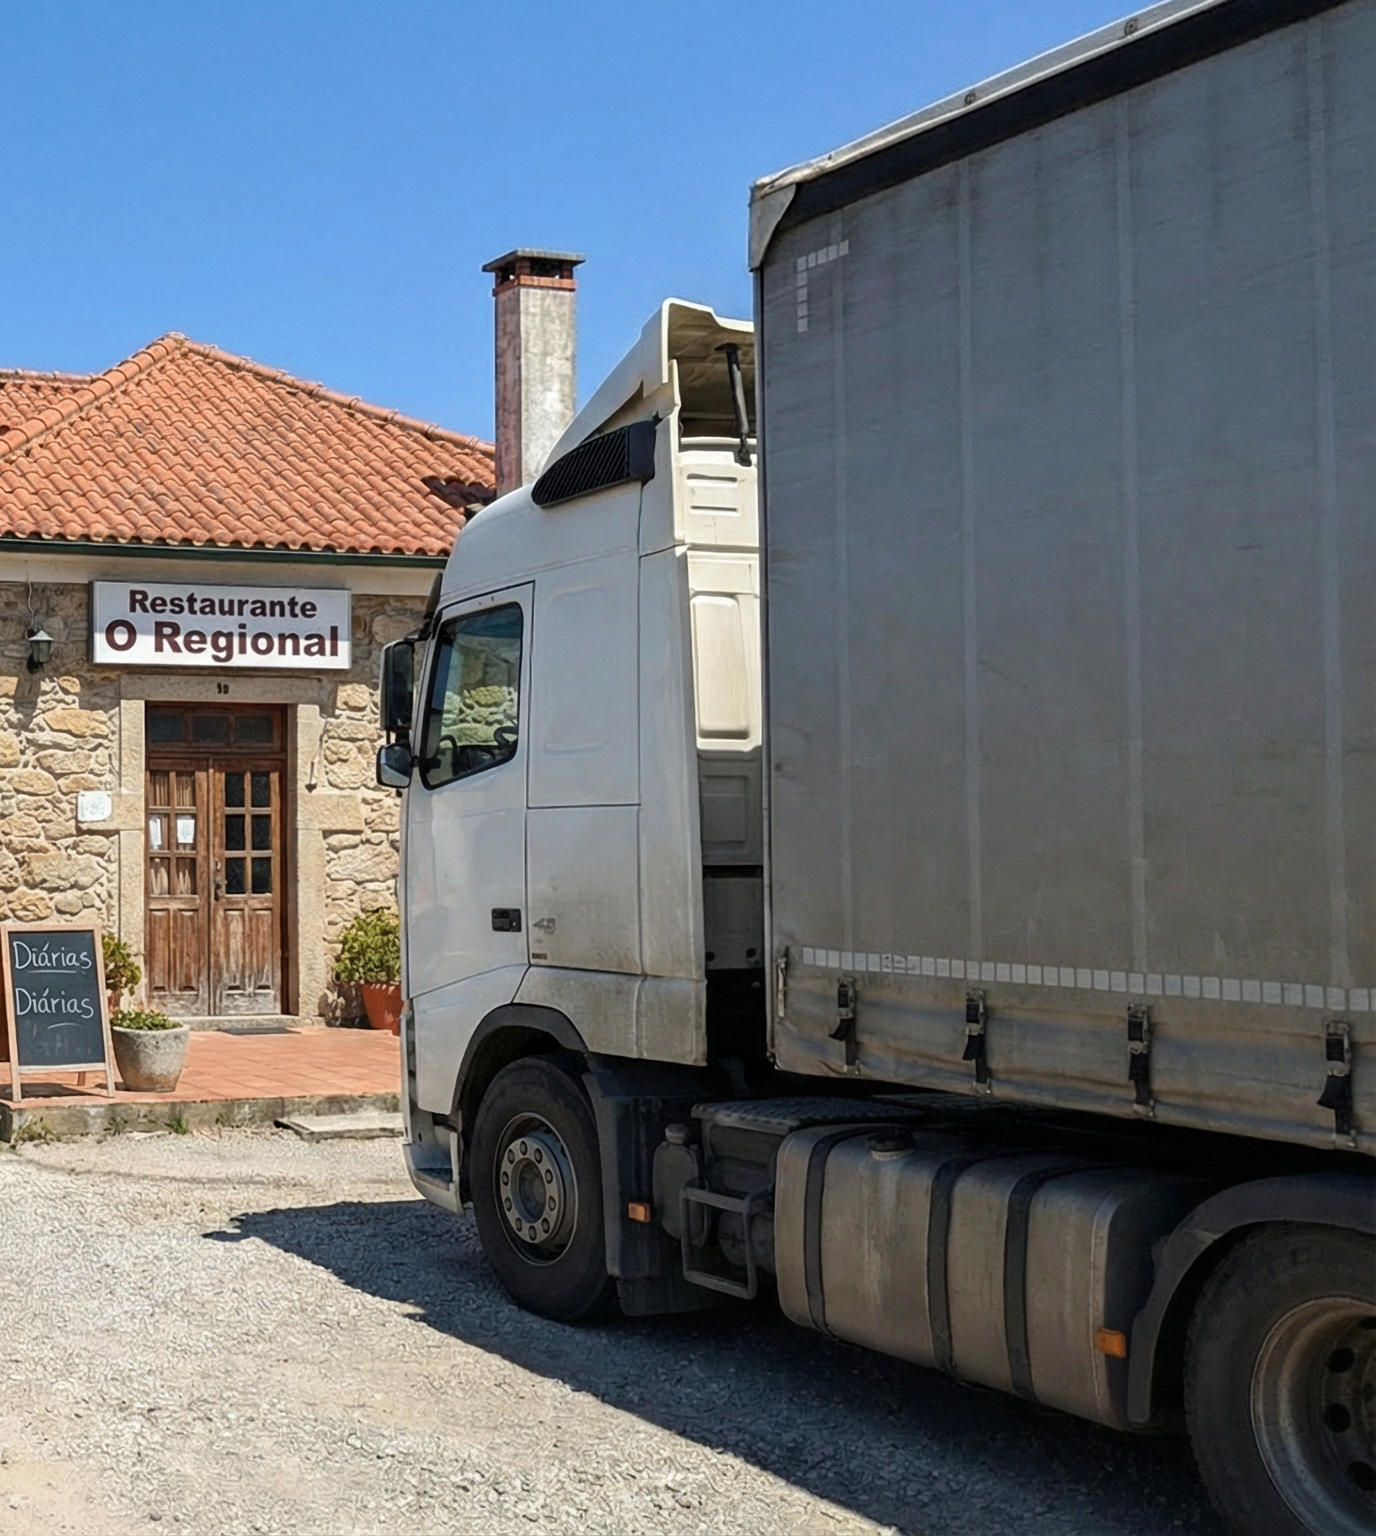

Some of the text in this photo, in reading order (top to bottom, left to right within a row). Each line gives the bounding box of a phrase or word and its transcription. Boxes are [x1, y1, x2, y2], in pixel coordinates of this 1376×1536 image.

[129, 589, 317, 619] Restaurante
[105, 619, 339, 663] O Regional
[13, 941, 92, 969] Diárias
[15, 988, 94, 1019] Diárias
